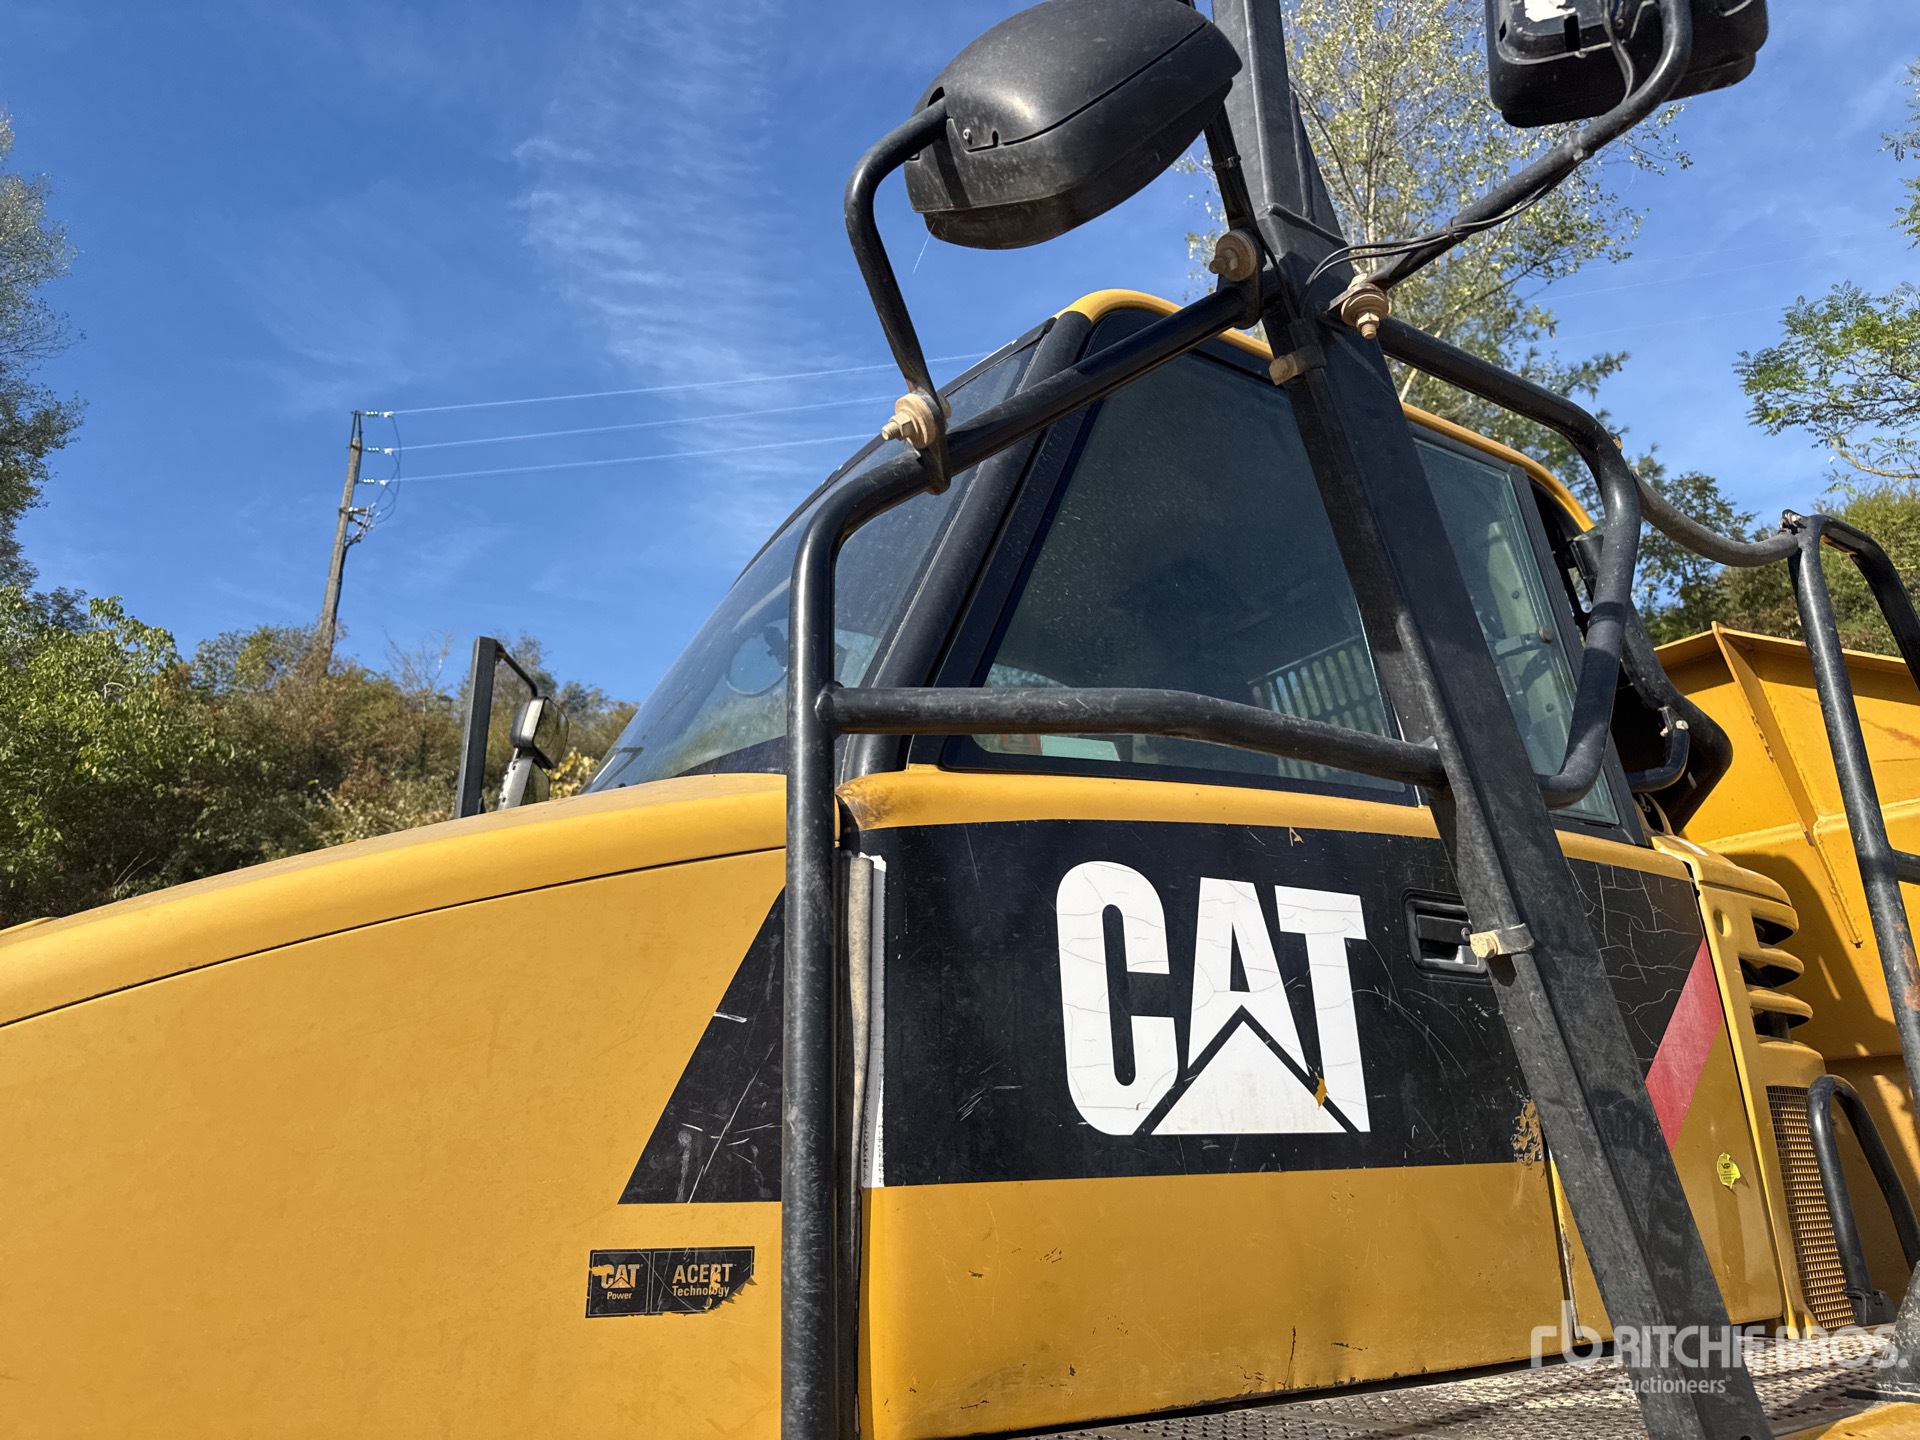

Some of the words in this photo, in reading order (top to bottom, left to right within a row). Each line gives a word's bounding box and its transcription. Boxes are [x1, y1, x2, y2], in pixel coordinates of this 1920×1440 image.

[1056, 860, 1371, 1136] CAT
[600, 1263, 641, 1289] CAT
[672, 1263, 734, 1284] ACERT
[606, 1291, 632, 1300] Power
[671, 1285, 730, 1297] Technology
